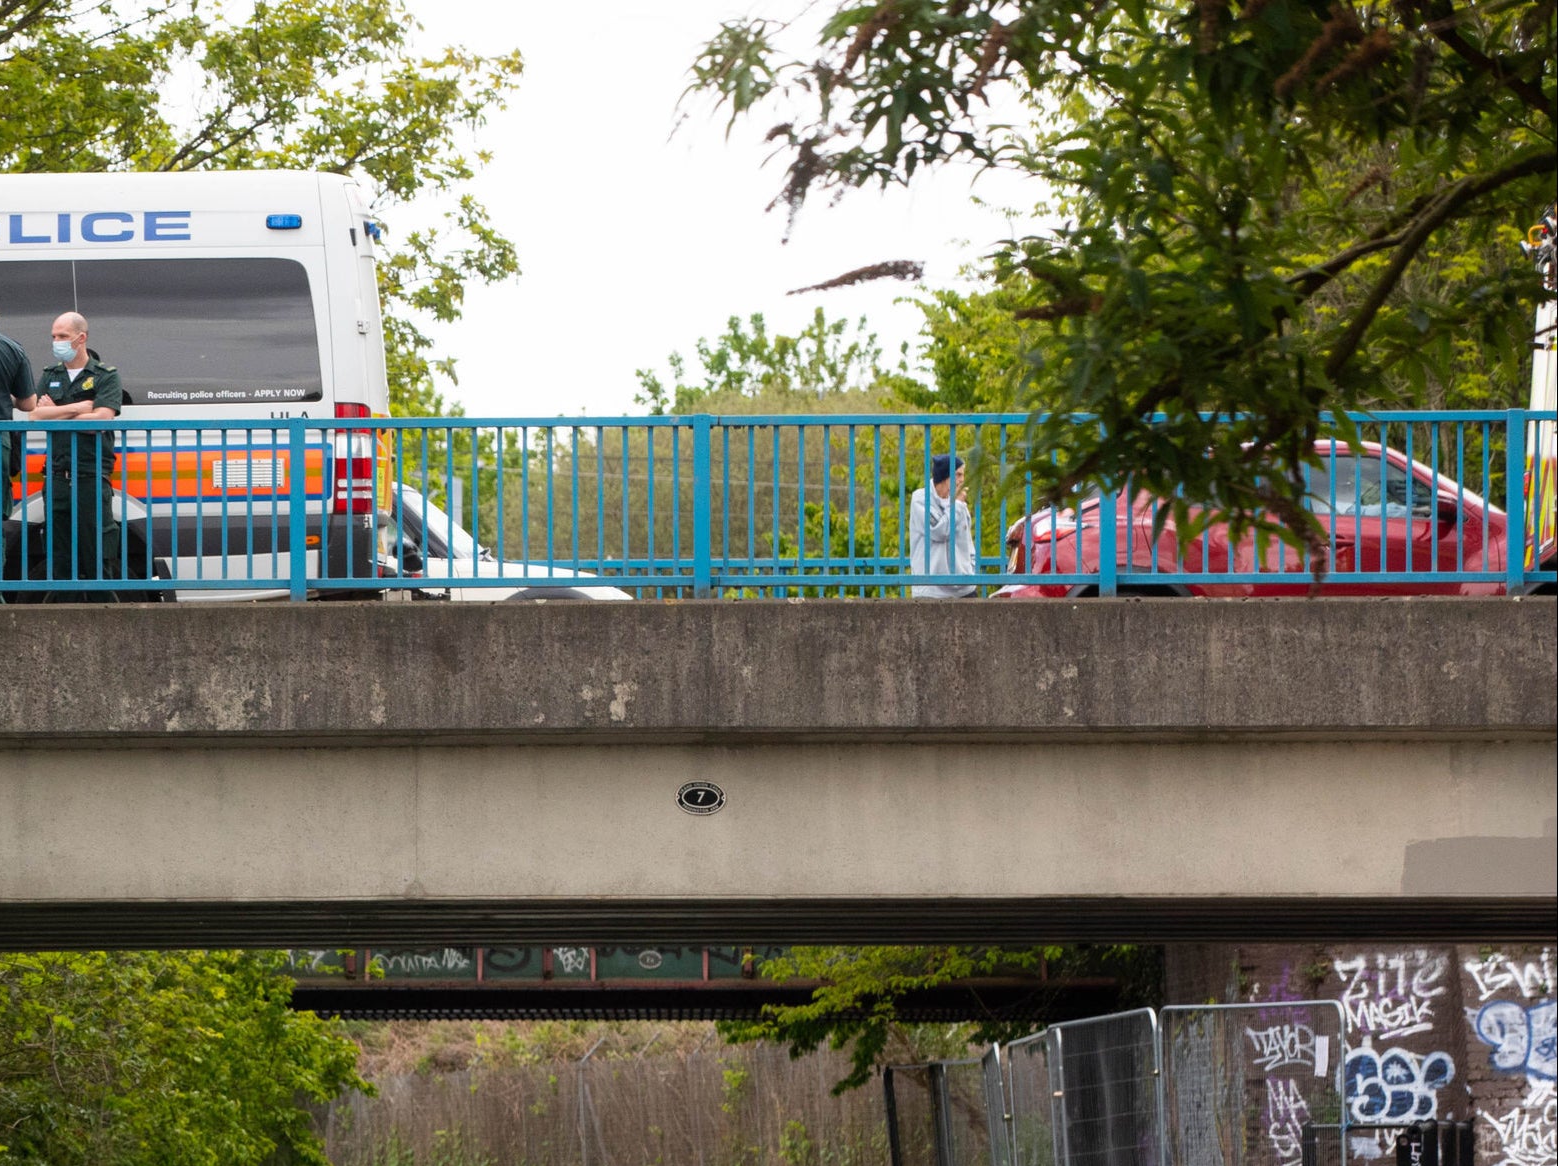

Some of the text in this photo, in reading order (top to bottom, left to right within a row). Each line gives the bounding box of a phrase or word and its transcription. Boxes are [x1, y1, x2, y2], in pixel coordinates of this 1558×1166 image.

[147, 391, 188, 400] Recruiting
[190, 391, 214, 400] police
[216, 390, 246, 398] officers
[254, 389, 281, 398] APPLY
[283, 389, 306, 397] NOW
[697, 791, 705, 803] 7
